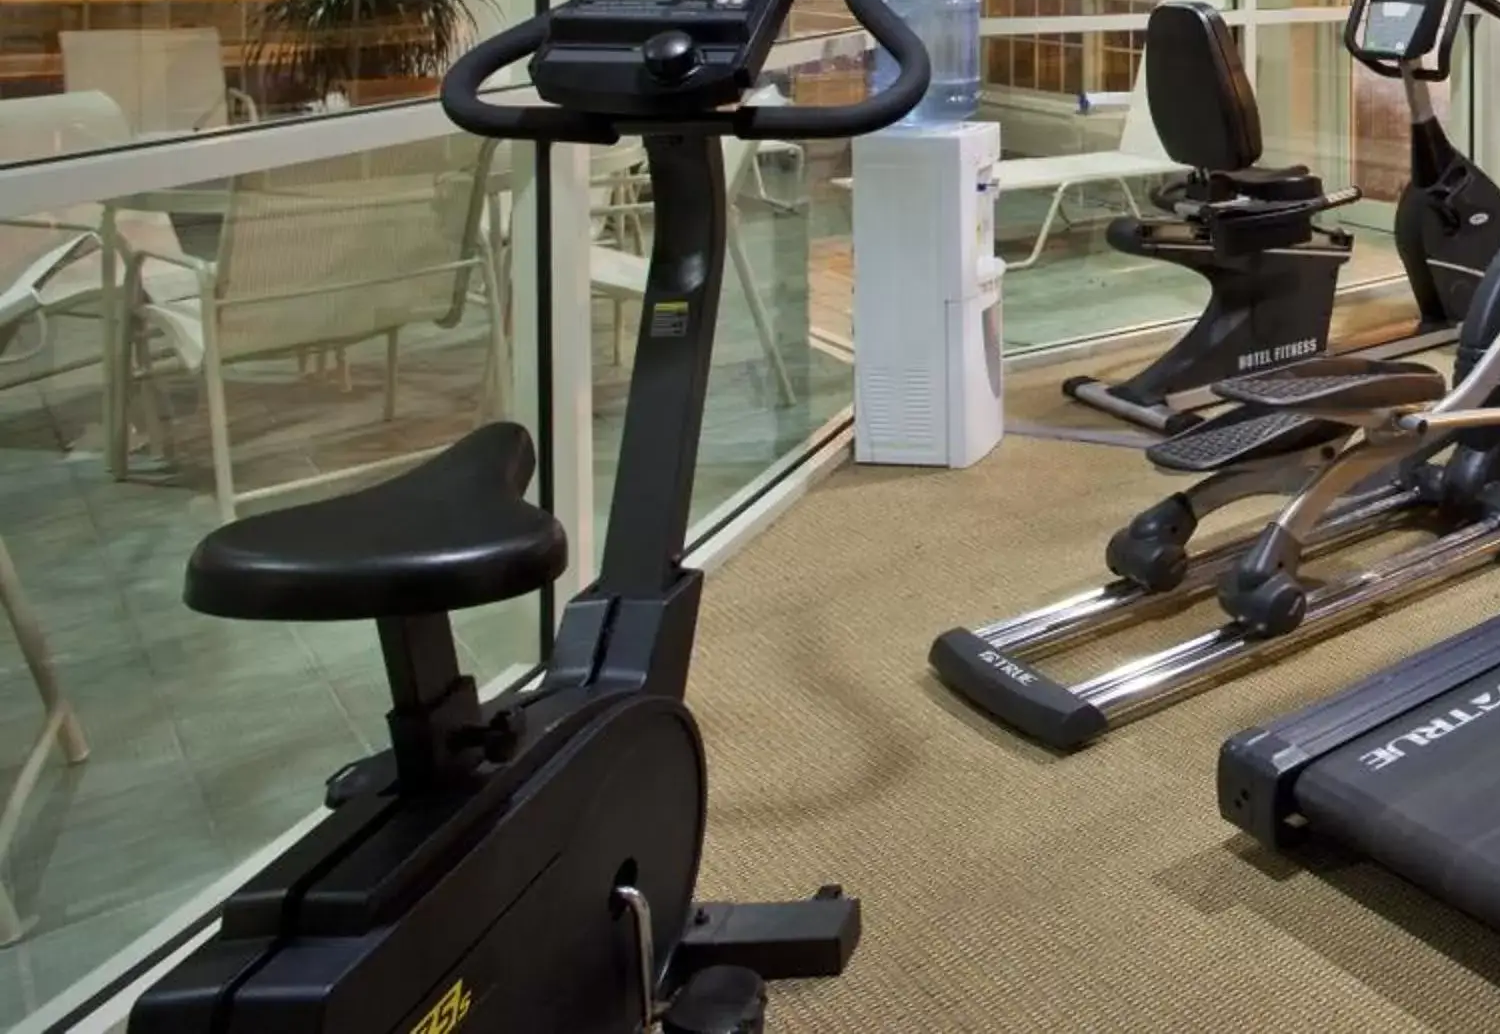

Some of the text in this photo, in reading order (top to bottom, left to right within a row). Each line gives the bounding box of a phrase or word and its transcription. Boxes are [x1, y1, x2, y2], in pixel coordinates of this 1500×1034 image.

[1238, 338, 1317, 370] HOTEL FITNESS
[1358, 708, 1484, 771] TRUE
